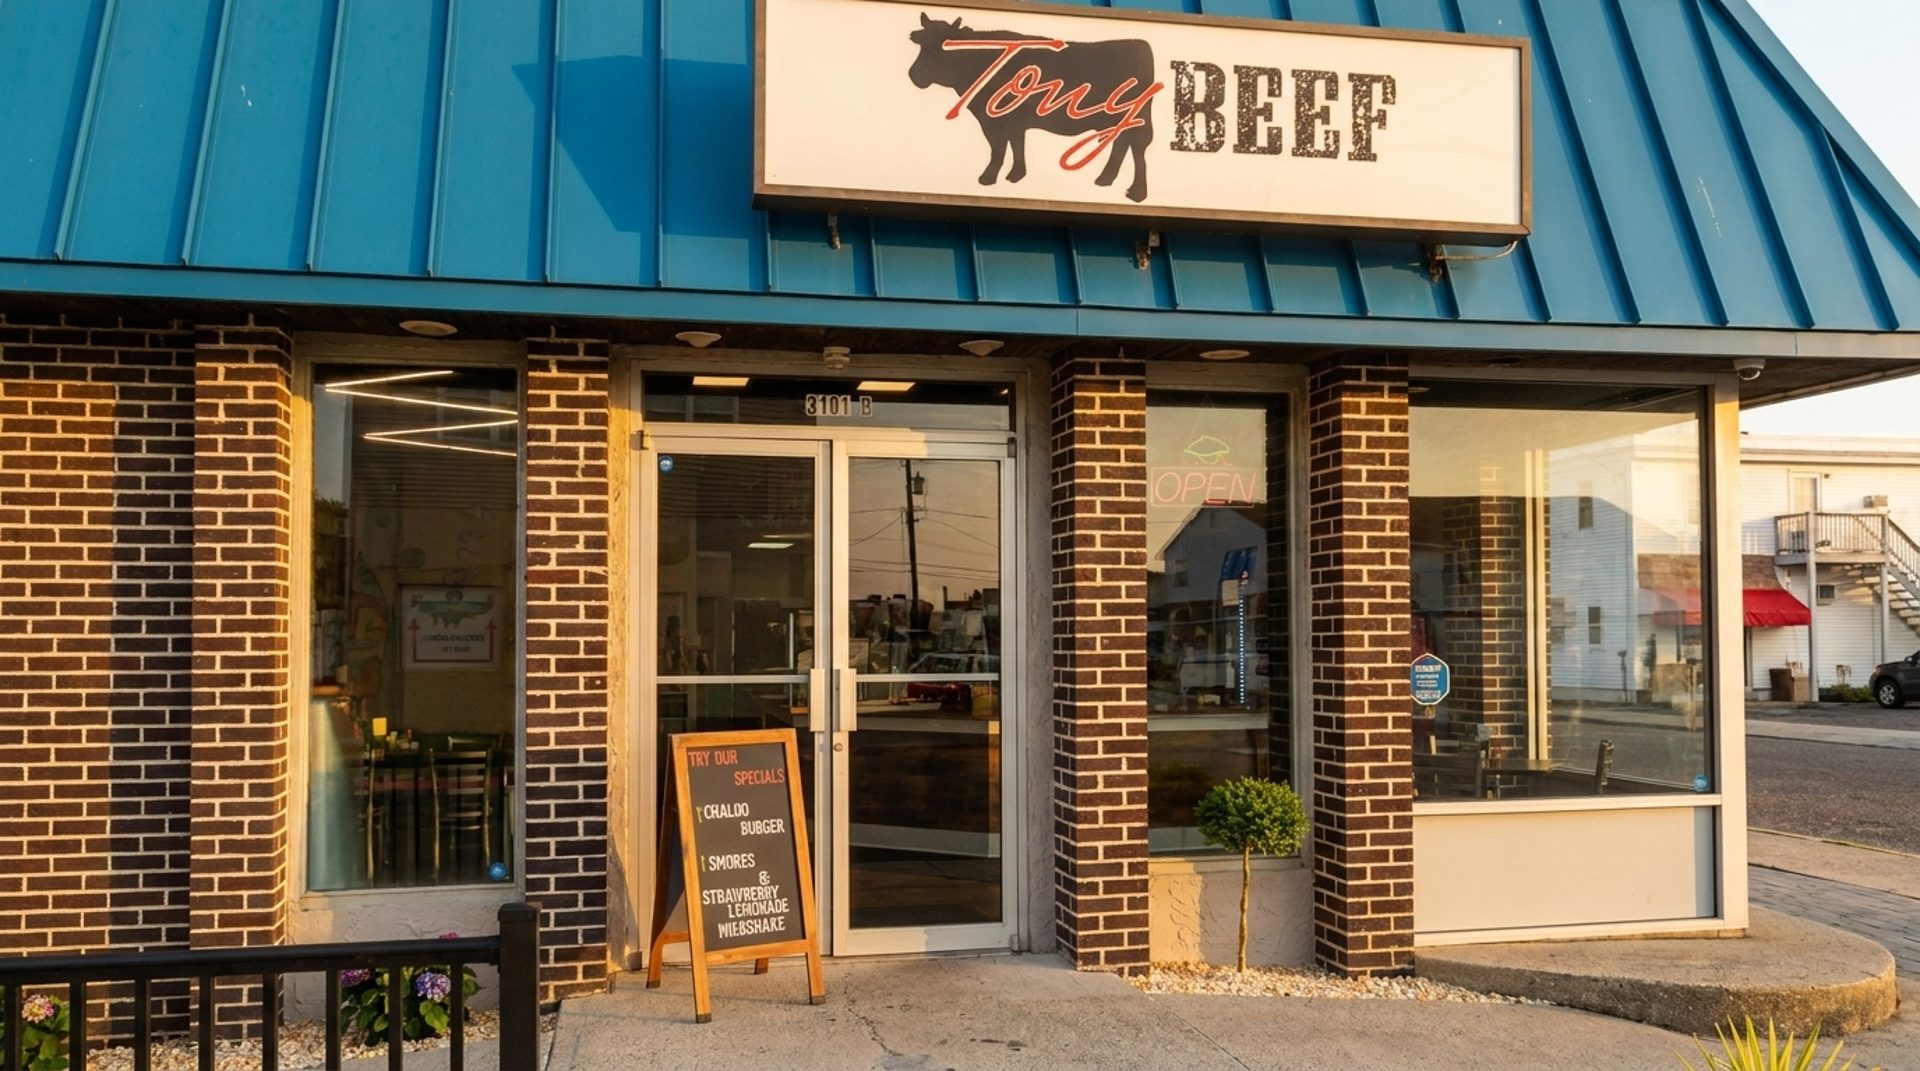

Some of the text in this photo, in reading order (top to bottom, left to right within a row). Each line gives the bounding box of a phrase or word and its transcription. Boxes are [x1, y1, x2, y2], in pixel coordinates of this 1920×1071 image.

[943, 38, 1396, 171] Tony BEEF
[806, 394, 872, 416] 3101 B
[1155, 472, 1257, 504] OPEN
[688, 750, 738, 767] TRY OUR
[734, 768, 785, 786] SPECIALS
[708, 853, 755, 871] SMORES
[759, 871, 771, 885] &
